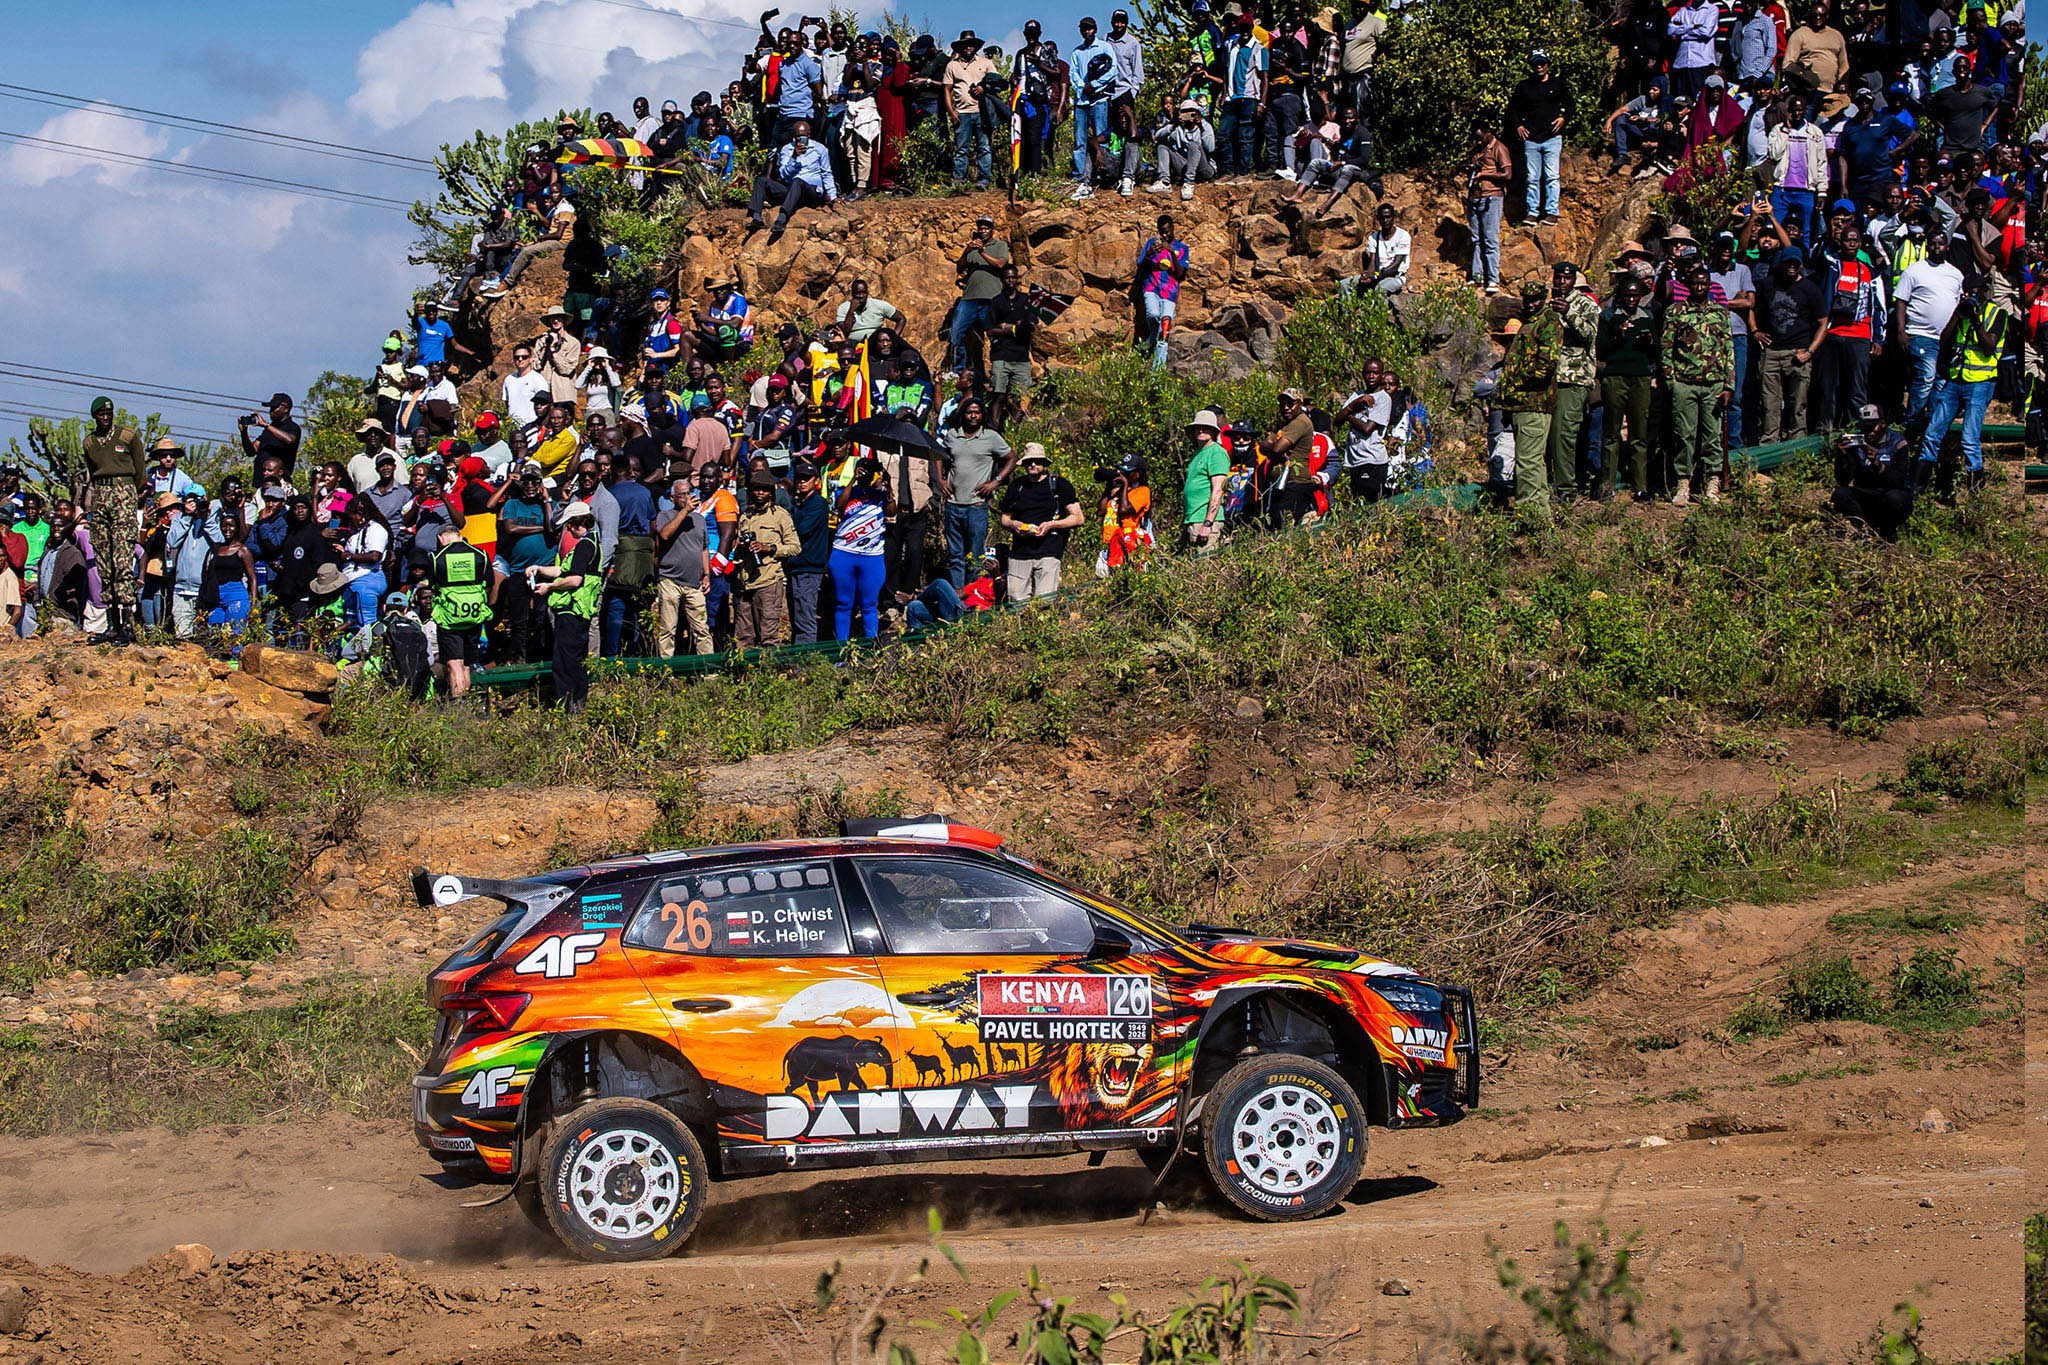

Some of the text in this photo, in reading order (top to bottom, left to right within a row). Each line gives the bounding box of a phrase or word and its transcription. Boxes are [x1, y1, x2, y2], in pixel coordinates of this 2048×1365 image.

[452, 602, 480, 618] 198
[582, 902, 623, 913] Szerokiej
[582, 911, 607, 920] Drogi
[751, 907, 833, 924] D. Chwist
[660, 899, 712, 951] 26
[753, 928, 826, 944] K. Heller
[514, 932, 606, 979] 4F
[1001, 981, 1087, 1004] KENYA
[1113, 978, 1147, 1016] 26
[984, 1021, 1125, 1039] PAVEL HORTEK
[1391, 1026, 1448, 1049] DANWAY
[461, 1065, 516, 1109] 4F
[766, 1085, 1038, 1139] DANWAY
